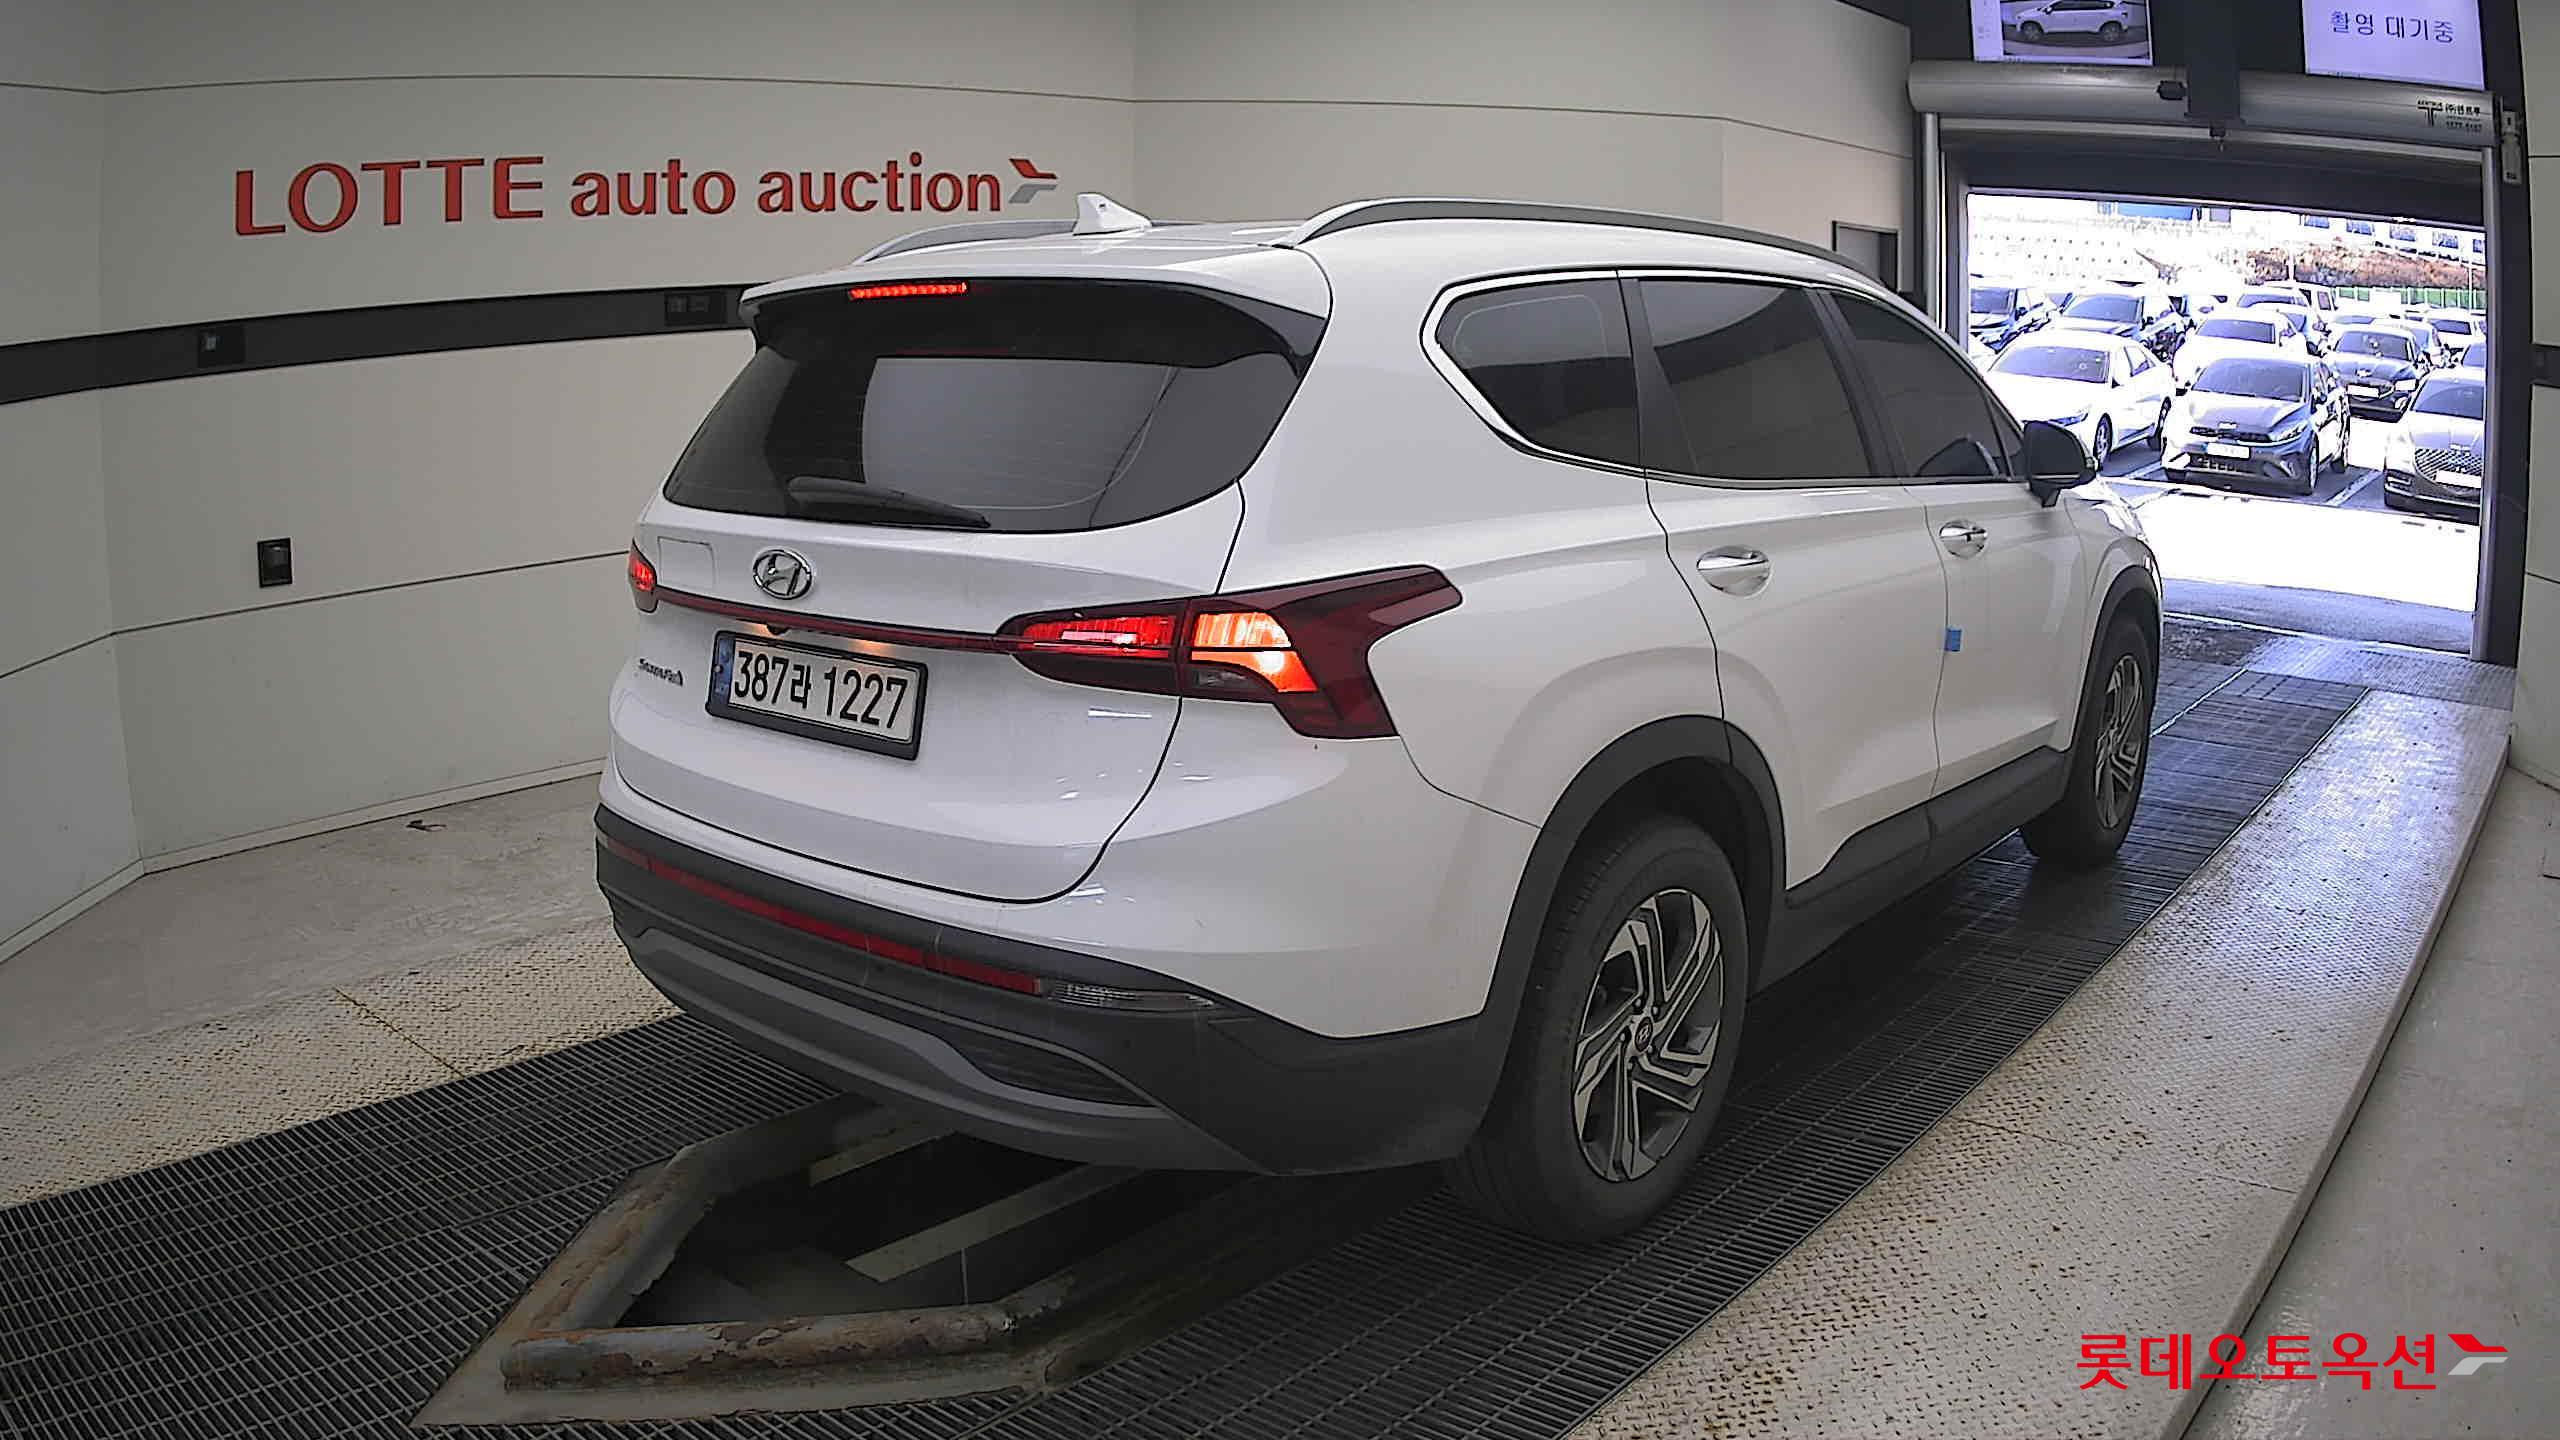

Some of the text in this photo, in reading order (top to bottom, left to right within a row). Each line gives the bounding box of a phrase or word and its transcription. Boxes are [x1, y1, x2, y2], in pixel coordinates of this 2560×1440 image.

[2331, 11, 2454, 44] 촬영 대기중
[235, 152, 1001, 236] LOTTE auto auction
[733, 651, 812, 709] 387라
[824, 666, 908, 729] 1227
